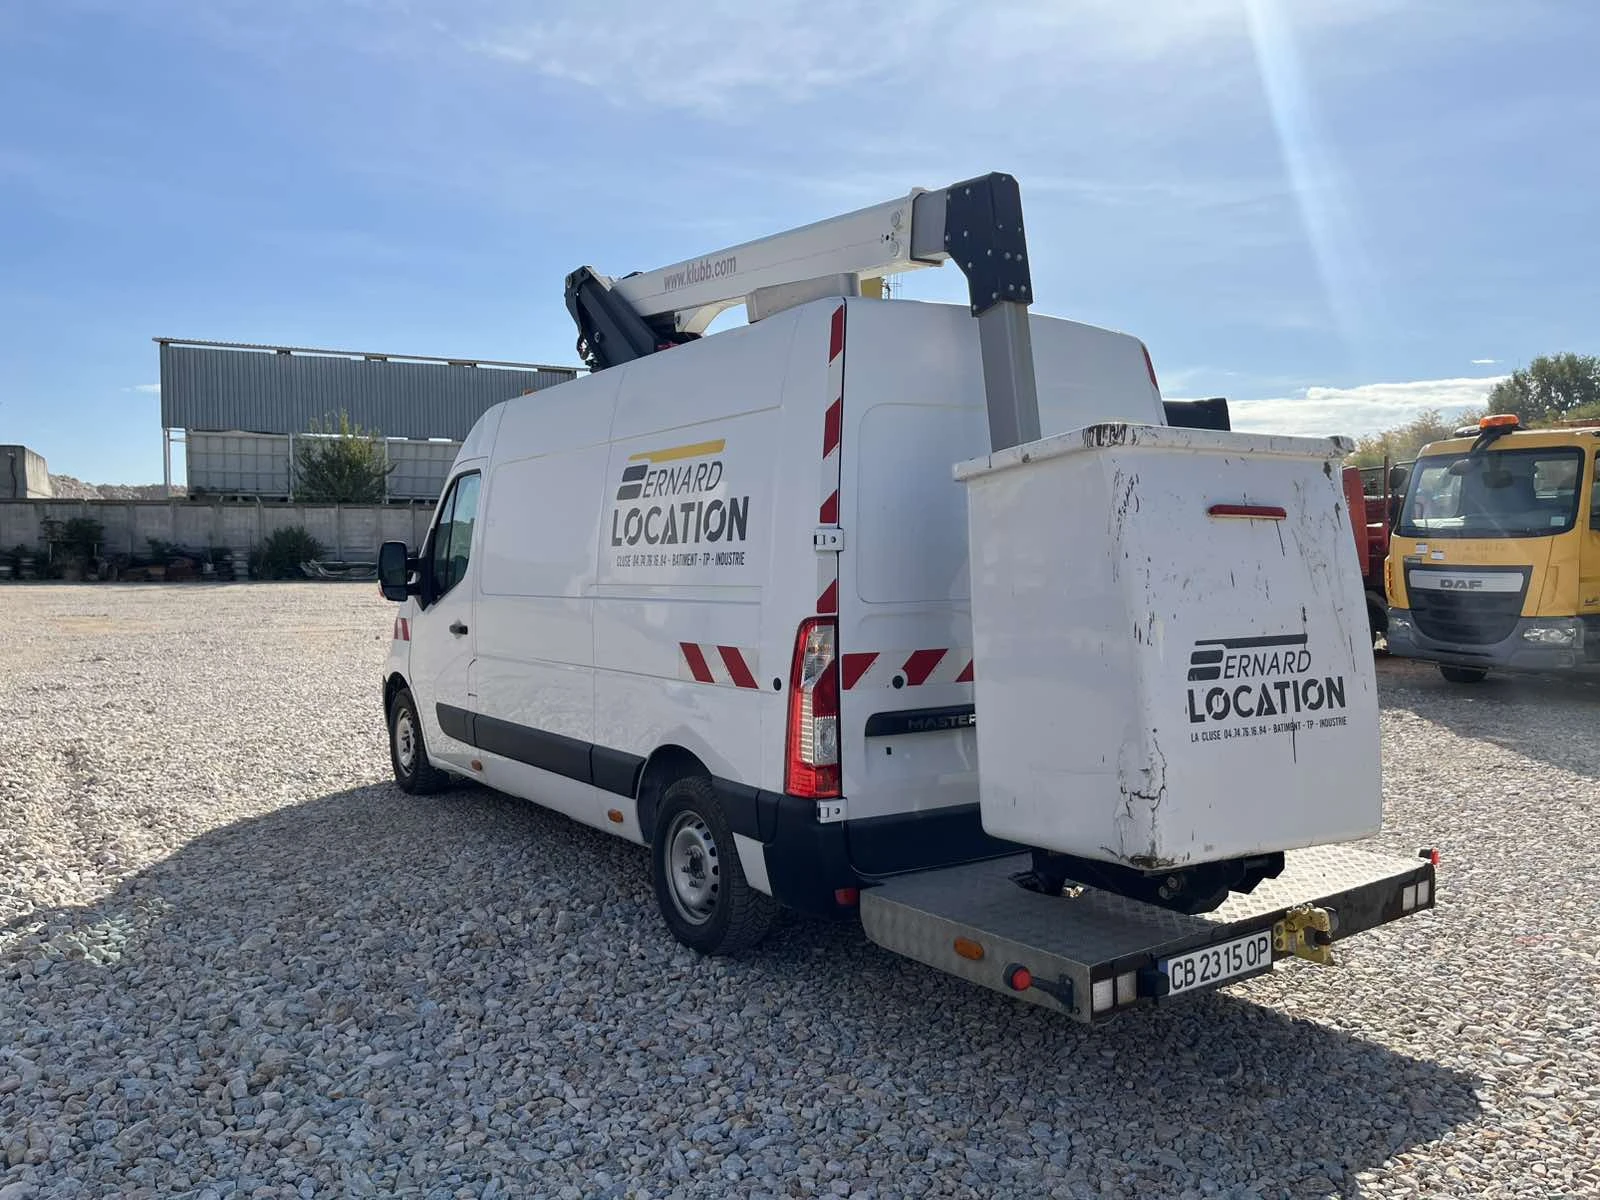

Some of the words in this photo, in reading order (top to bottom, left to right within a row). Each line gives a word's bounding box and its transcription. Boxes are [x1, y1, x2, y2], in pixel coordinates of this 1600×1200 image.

[663, 256, 737, 292] www.klubb.com
[611, 496, 750, 547] LOCATION
[703, 552, 711, 566] TP
[715, 551, 745, 566] INDUSTRIE
[1440, 578, 1482, 590] DAF
[1187, 676, 1347, 724] LOCATION
[1190, 732, 1200, 743] LA
[1201, 729, 1222, 742] CLUSE
[1307, 719, 1314, 729] TP
[1319, 716, 1348, 729] INDUSTRIE
[1171, 957, 1197, 991] CB
[1199, 943, 1243, 983] 2315
[1246, 936, 1269, 967] OP
